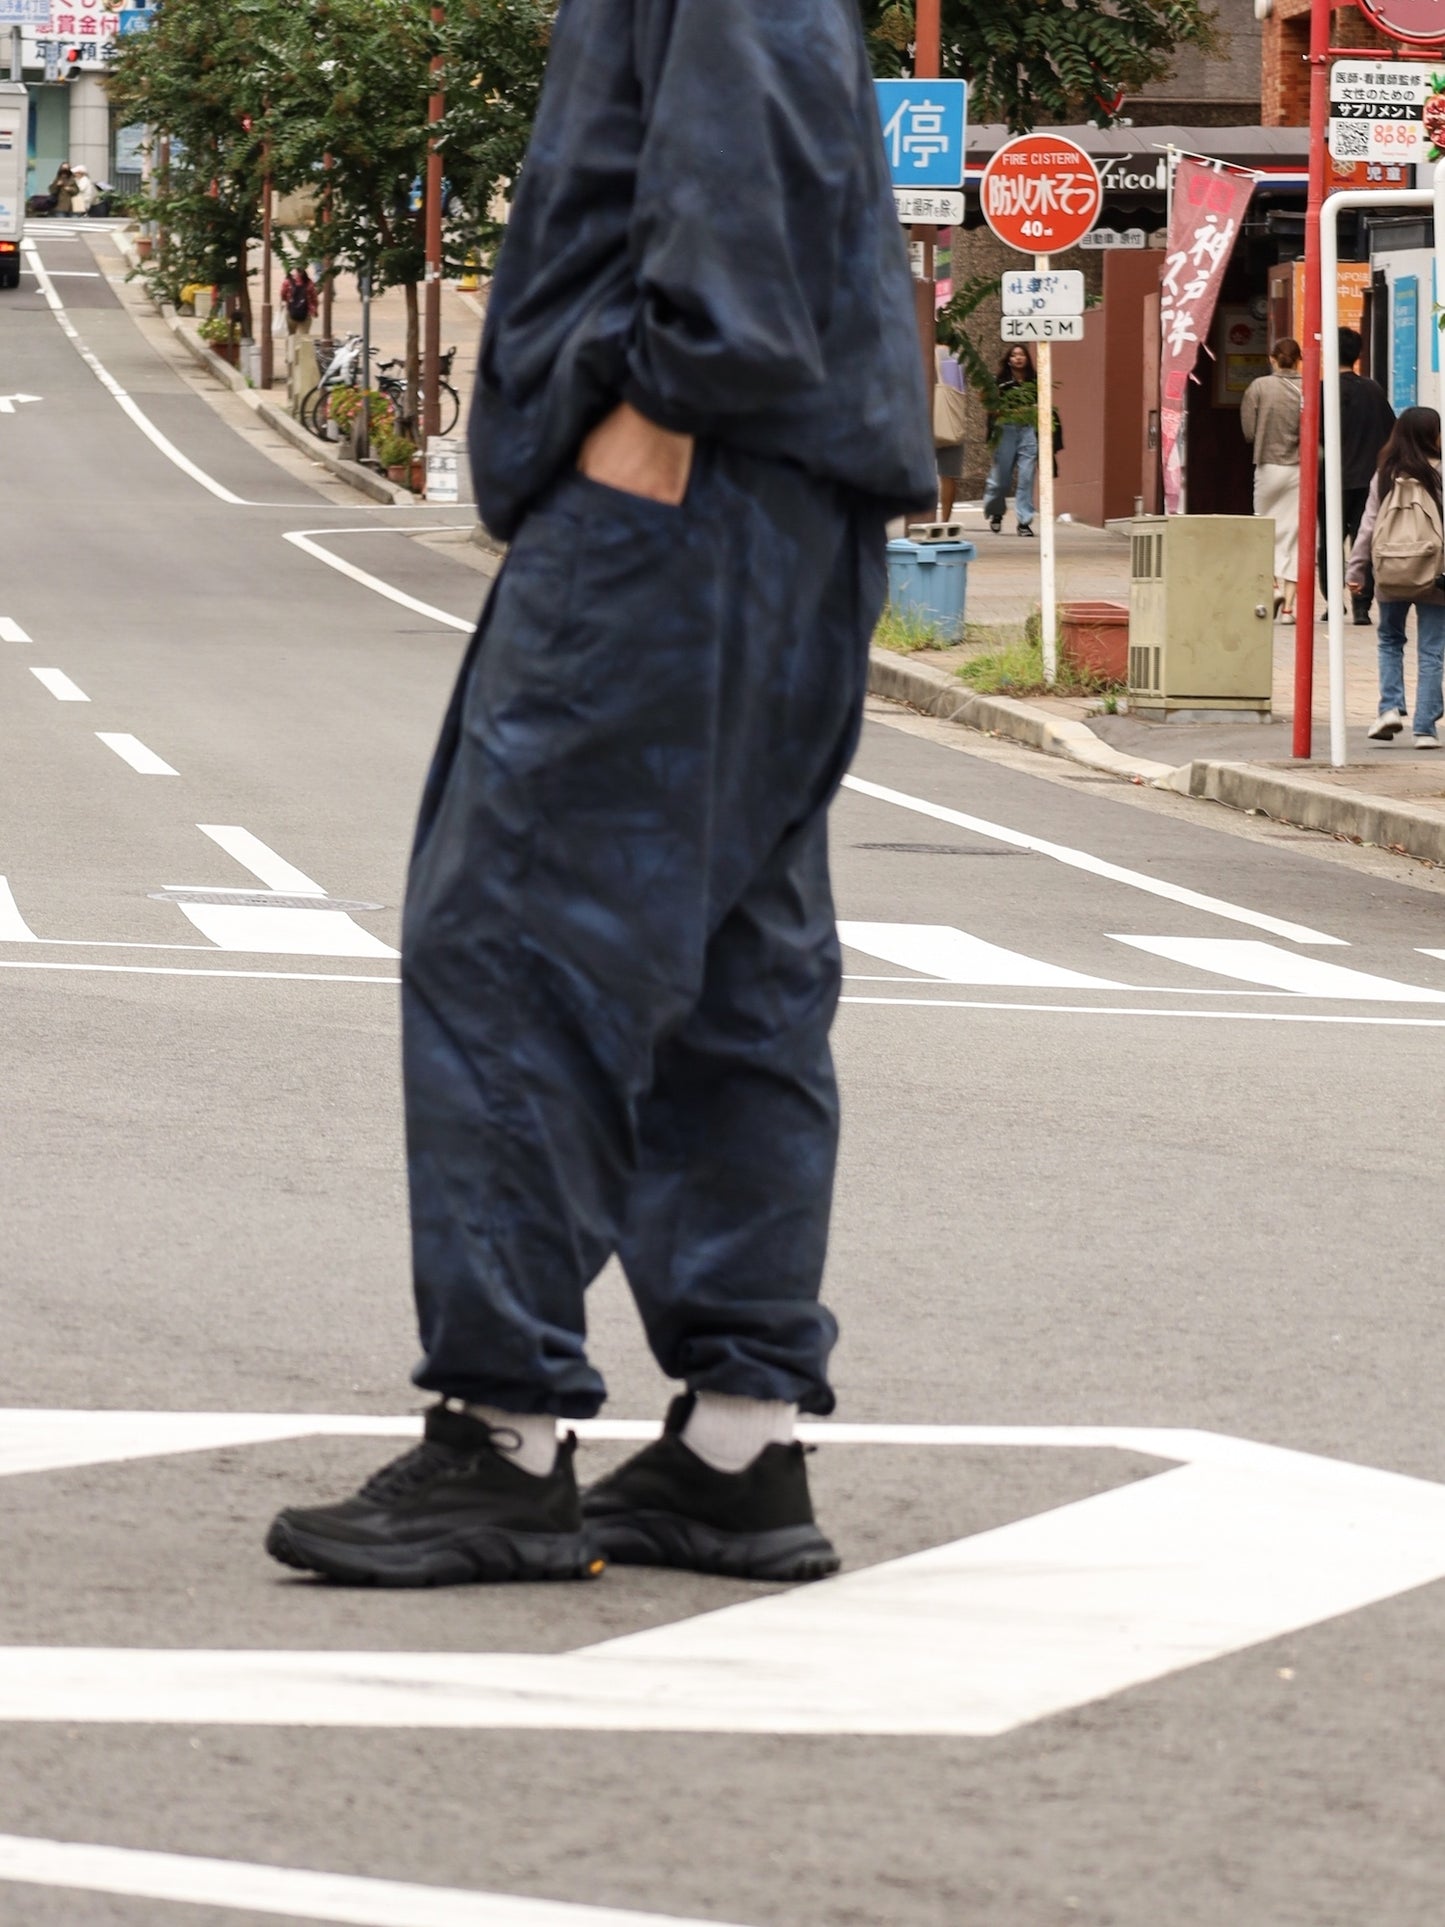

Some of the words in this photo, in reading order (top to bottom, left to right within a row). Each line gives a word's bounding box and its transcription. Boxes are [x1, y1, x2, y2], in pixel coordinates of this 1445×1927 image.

[1341, 88, 1415, 101] 女性のための
[1338, 103, 1416, 119] サプリメント
[883, 99, 949, 168] 停
[1002, 153, 1029, 166] FIRE
[1031, 152, 1079, 165] CISTERN
[1168, 215, 1234, 357] 神戸牛
